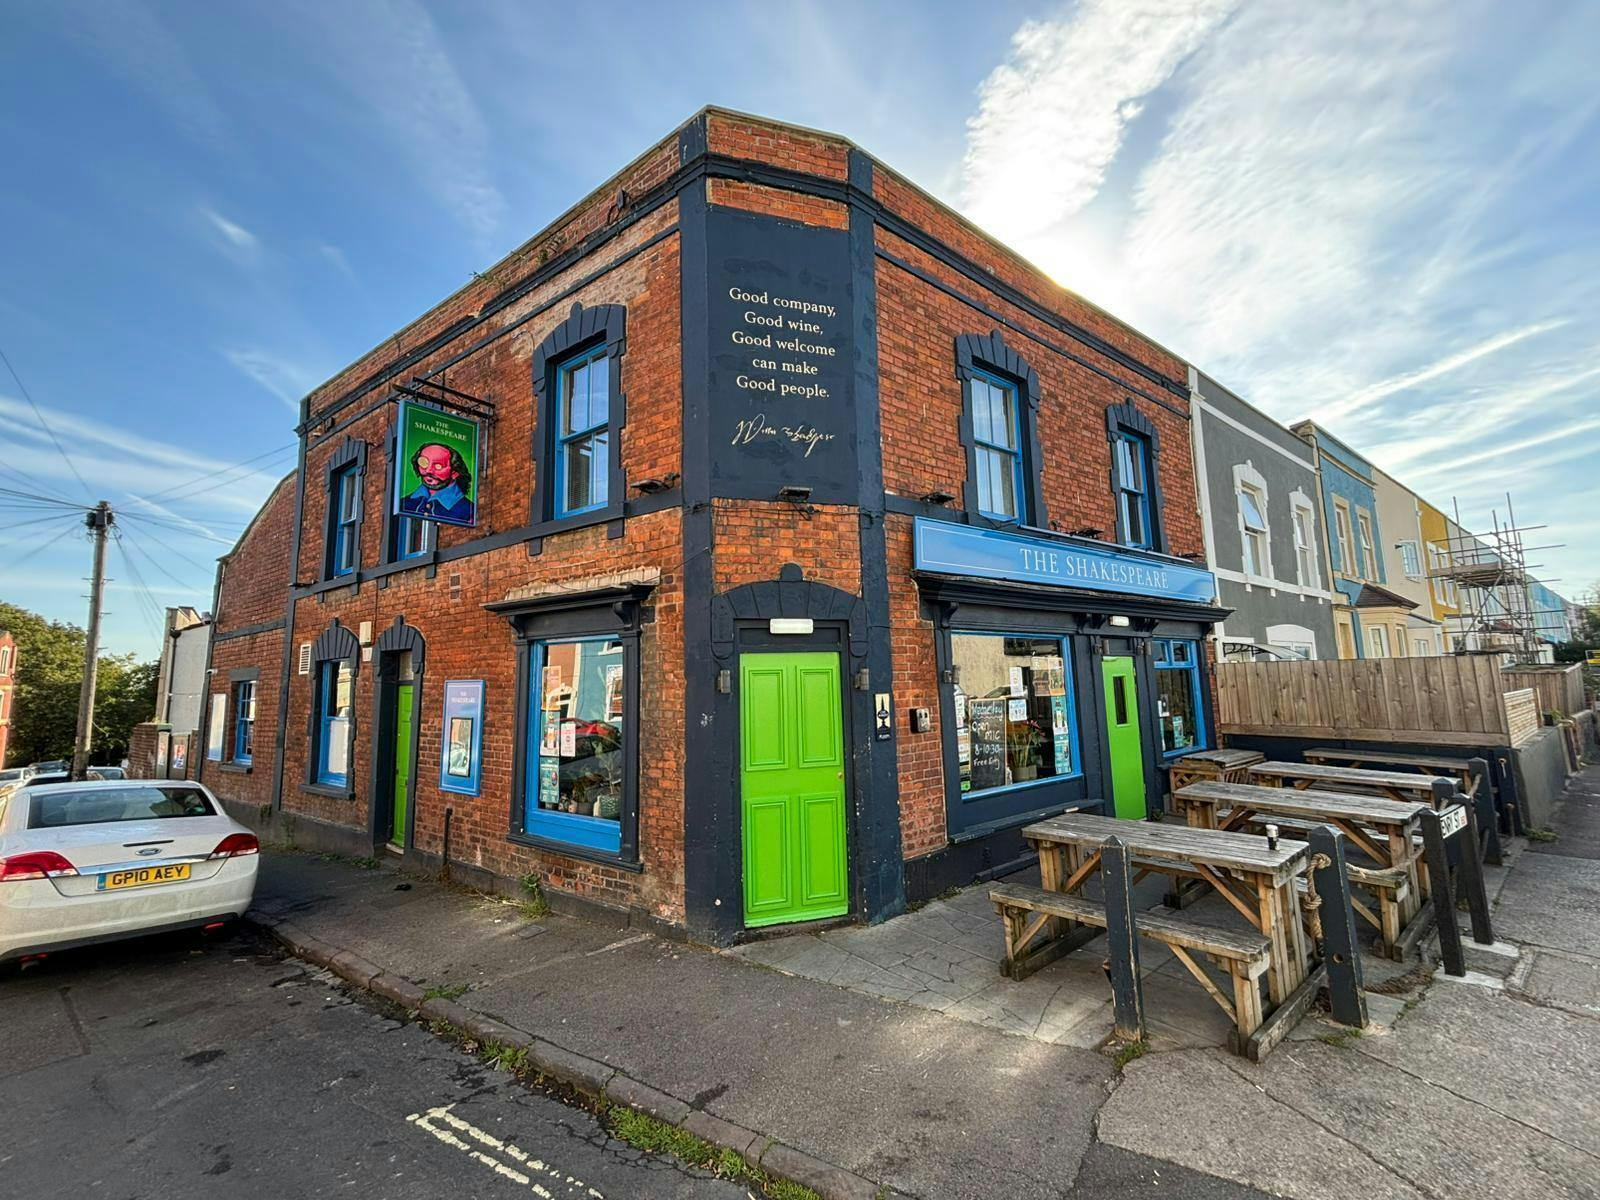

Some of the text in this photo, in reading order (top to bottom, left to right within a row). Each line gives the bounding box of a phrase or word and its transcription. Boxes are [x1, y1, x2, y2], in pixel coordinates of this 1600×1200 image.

[729, 287, 837, 317] Good company,
[744, 311, 824, 335] Good wine,
[731, 331, 836, 356] Good welcome
[752, 358, 818, 375] can make
[736, 375, 830, 399] Good people.
[414, 421, 467, 440] SHAKESPEARE
[436, 421, 449, 429] THE
[1020, 548, 1169, 588] THE SHAKESPEARE
[154, 866, 184, 880] AEY
